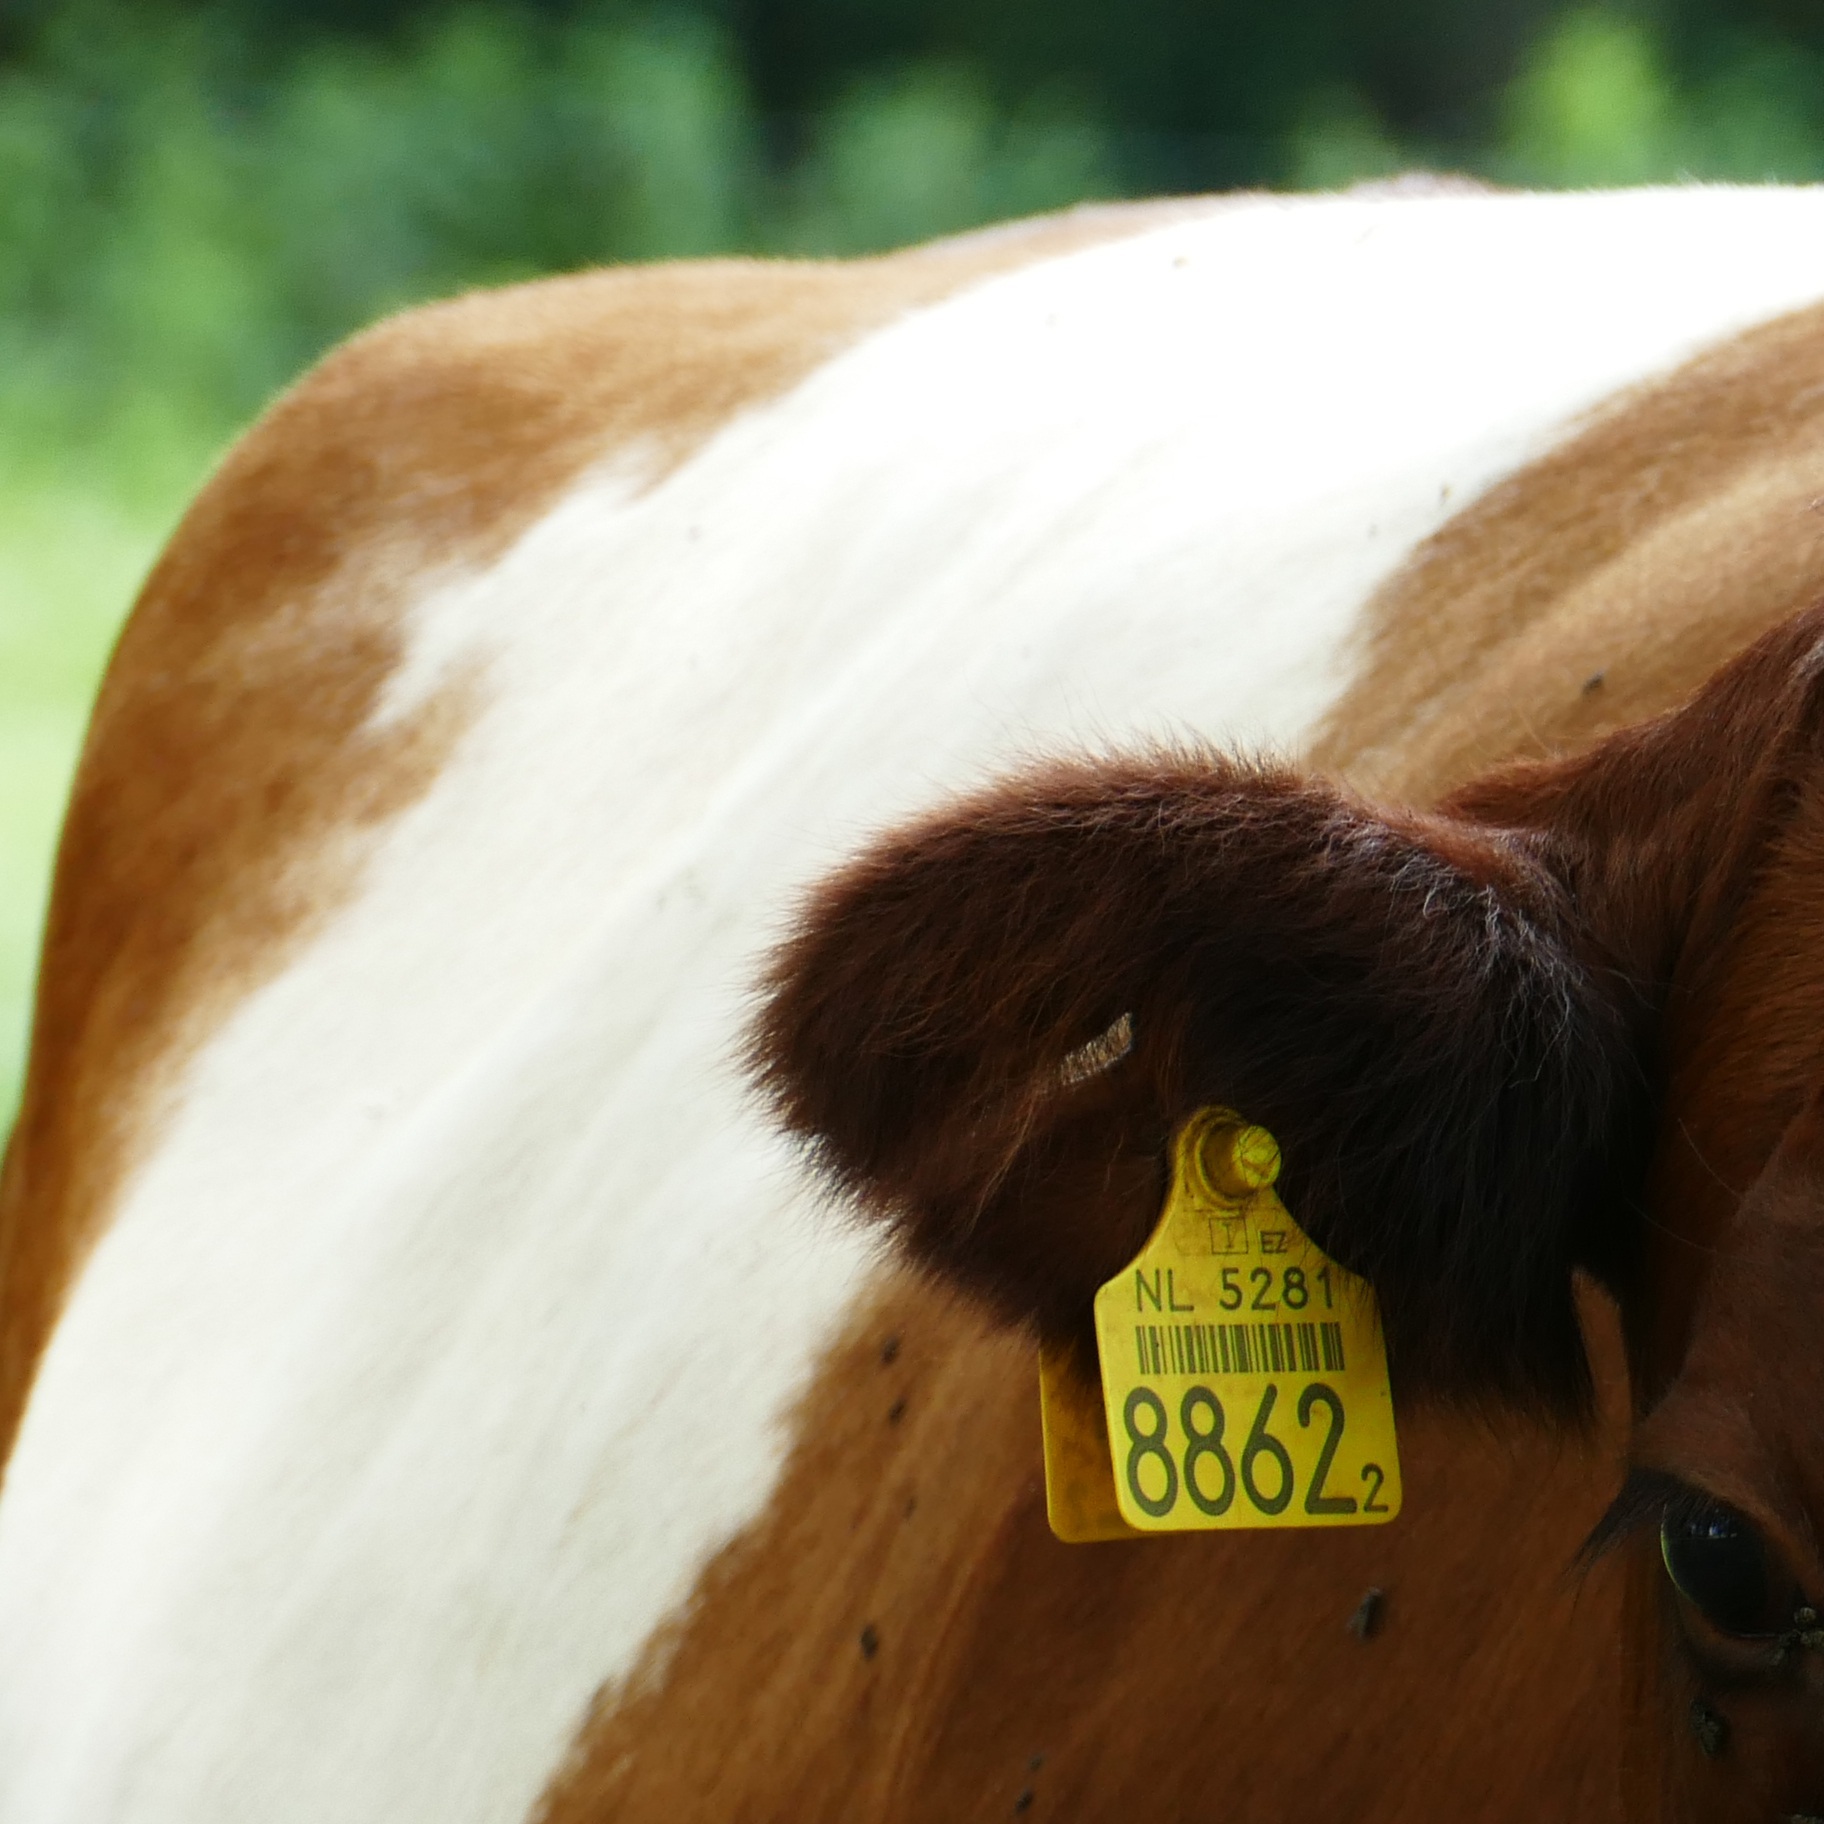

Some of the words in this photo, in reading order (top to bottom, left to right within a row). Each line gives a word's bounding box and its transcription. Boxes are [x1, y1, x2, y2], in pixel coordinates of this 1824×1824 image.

[1260, 1230, 1288, 1254] EZ
[1135, 1268, 1195, 1313] NL
[1219, 1266, 1334, 1312] 5281
